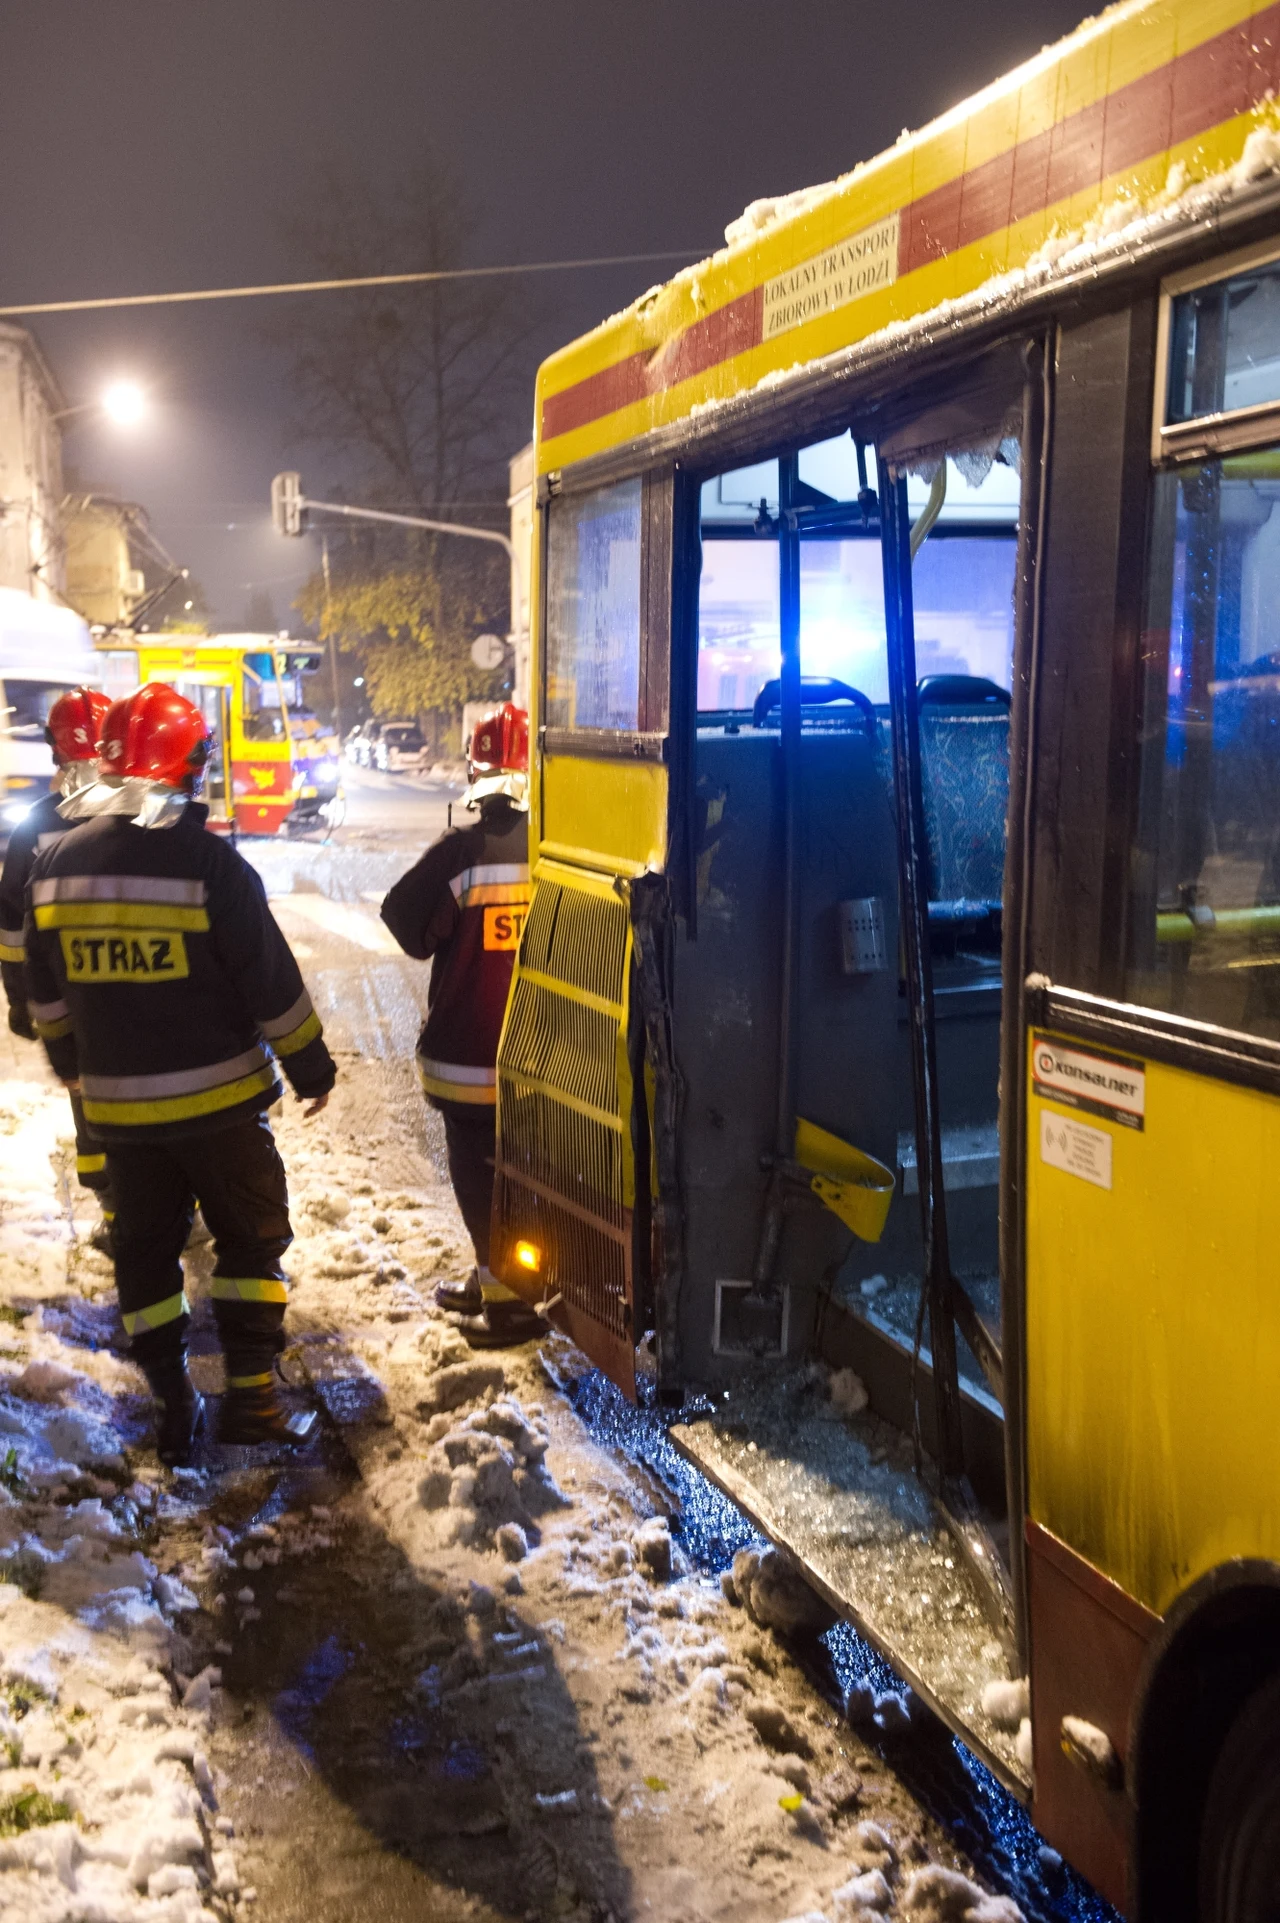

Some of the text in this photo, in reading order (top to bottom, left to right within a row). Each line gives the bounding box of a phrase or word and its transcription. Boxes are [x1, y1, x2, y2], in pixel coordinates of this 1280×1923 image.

[764, 224, 896, 305] LOKALNY TRANSPORT
[768, 286, 831, 332] ZBIOROWY
[833, 281, 846, 301] W
[74, 727, 88, 744] 3
[481, 734, 492, 752] 3
[107, 739, 123, 761] 3
